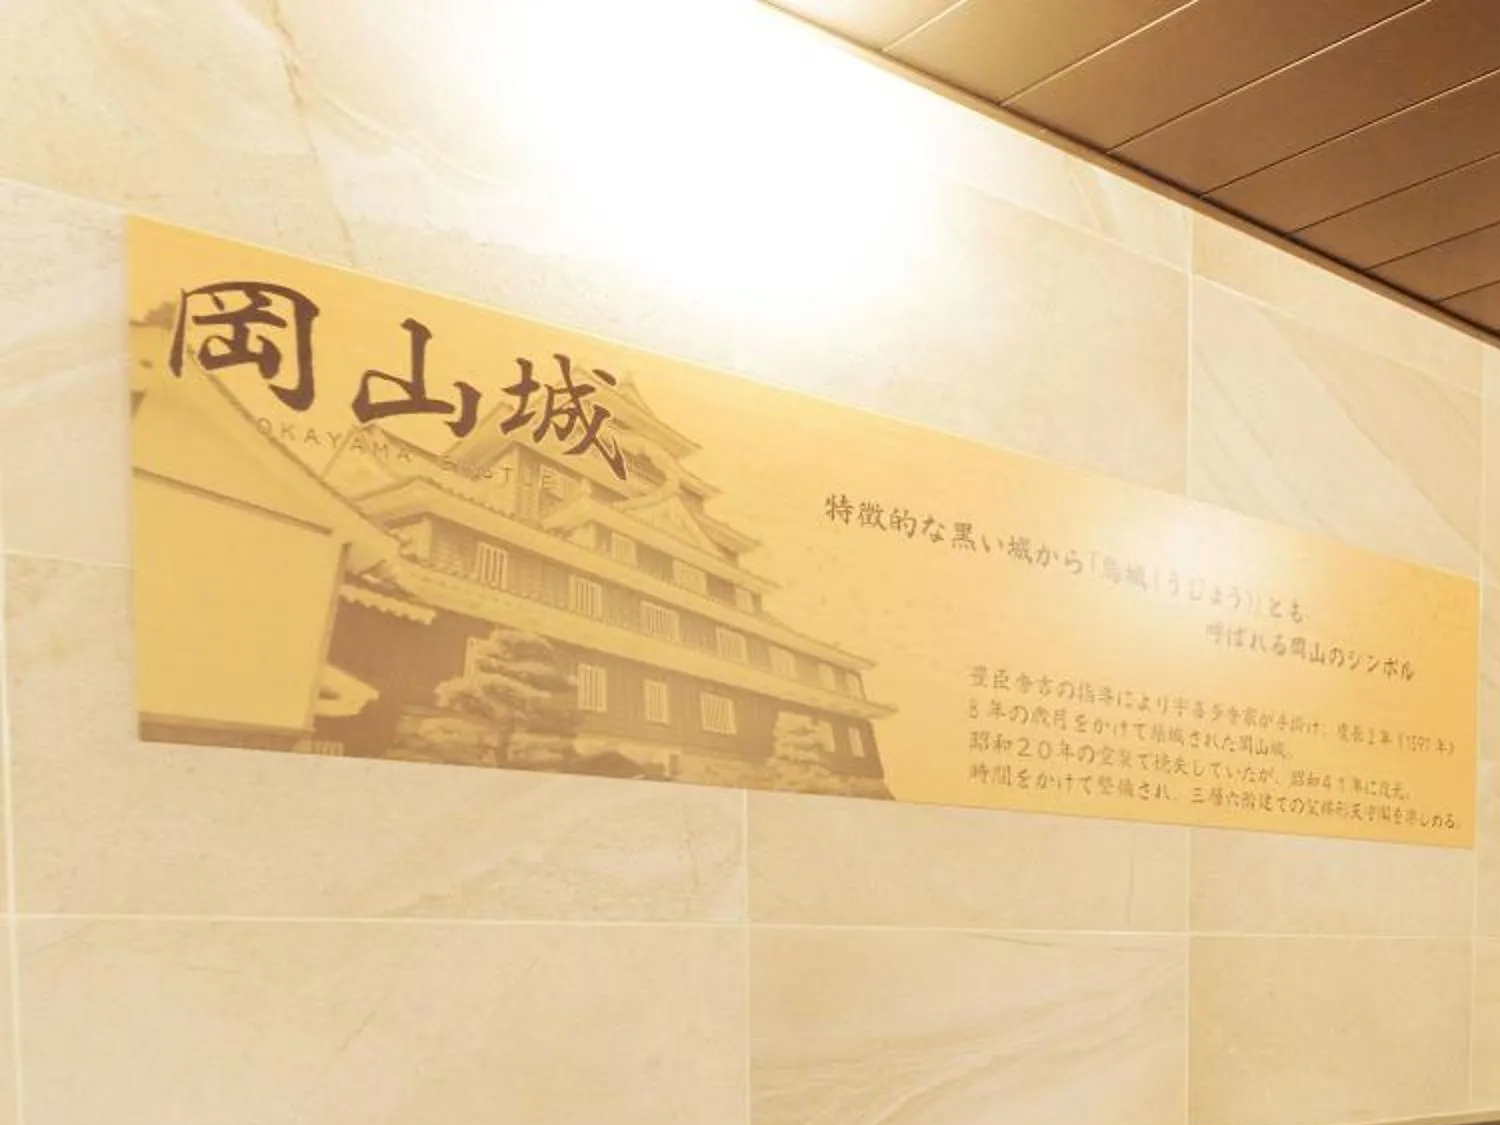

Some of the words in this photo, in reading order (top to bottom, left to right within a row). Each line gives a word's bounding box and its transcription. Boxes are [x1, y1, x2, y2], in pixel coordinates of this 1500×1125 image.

[169, 280, 629, 481] 岡山城
[255, 416, 414, 464] OKAYAMA
[440, 453, 556, 491] CSTLE
[1203, 622, 1417, 683] 呼ばれる岡山のシンボル
